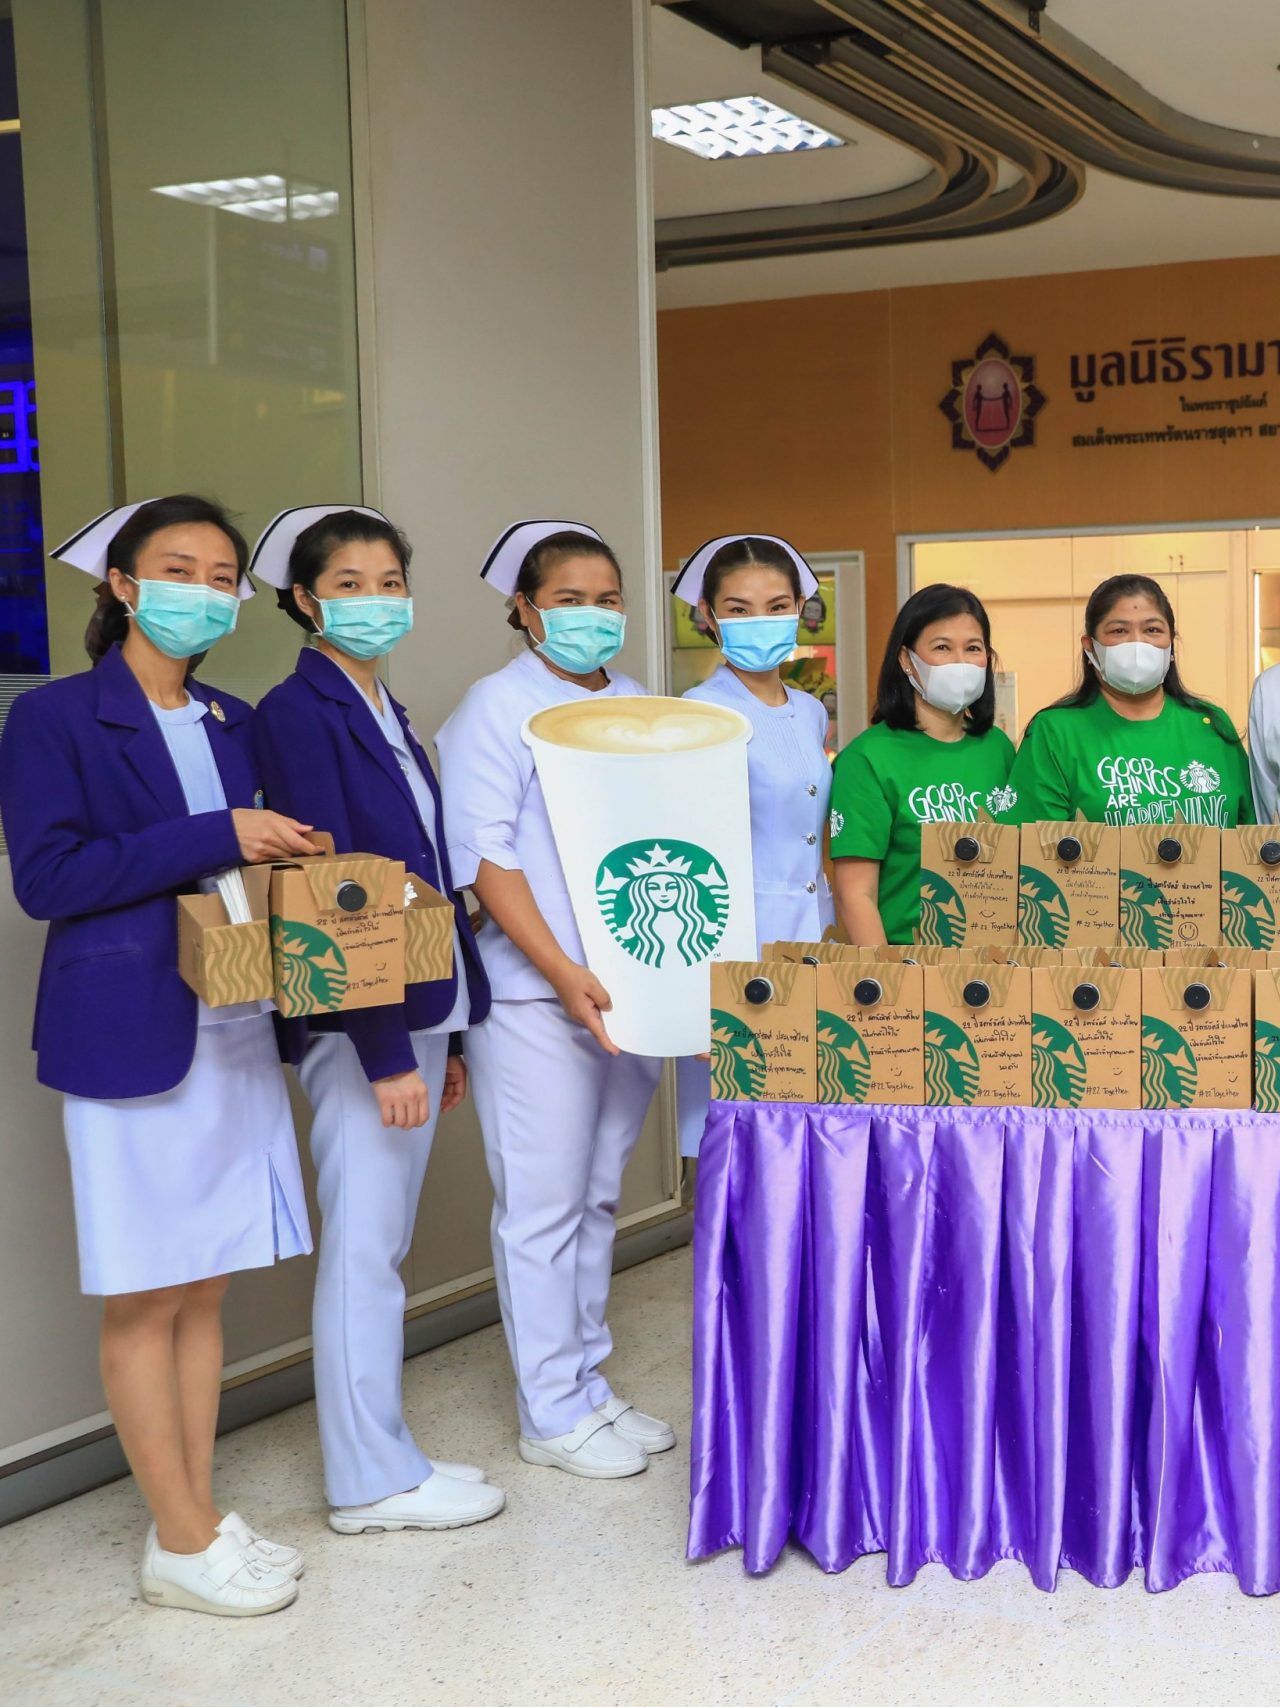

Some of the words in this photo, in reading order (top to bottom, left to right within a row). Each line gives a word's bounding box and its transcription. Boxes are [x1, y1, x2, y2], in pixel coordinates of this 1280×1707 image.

[1097, 757, 1154, 785] GOOD
[1102, 767, 1181, 797] THINGS
[908, 783, 963, 818] GOOD
[1107, 794, 1141, 809] ARE
[992, 1089, 1021, 1098] Together
[1101, 1087, 1128, 1096] Together
[1213, 1088, 1240, 1098] Together
